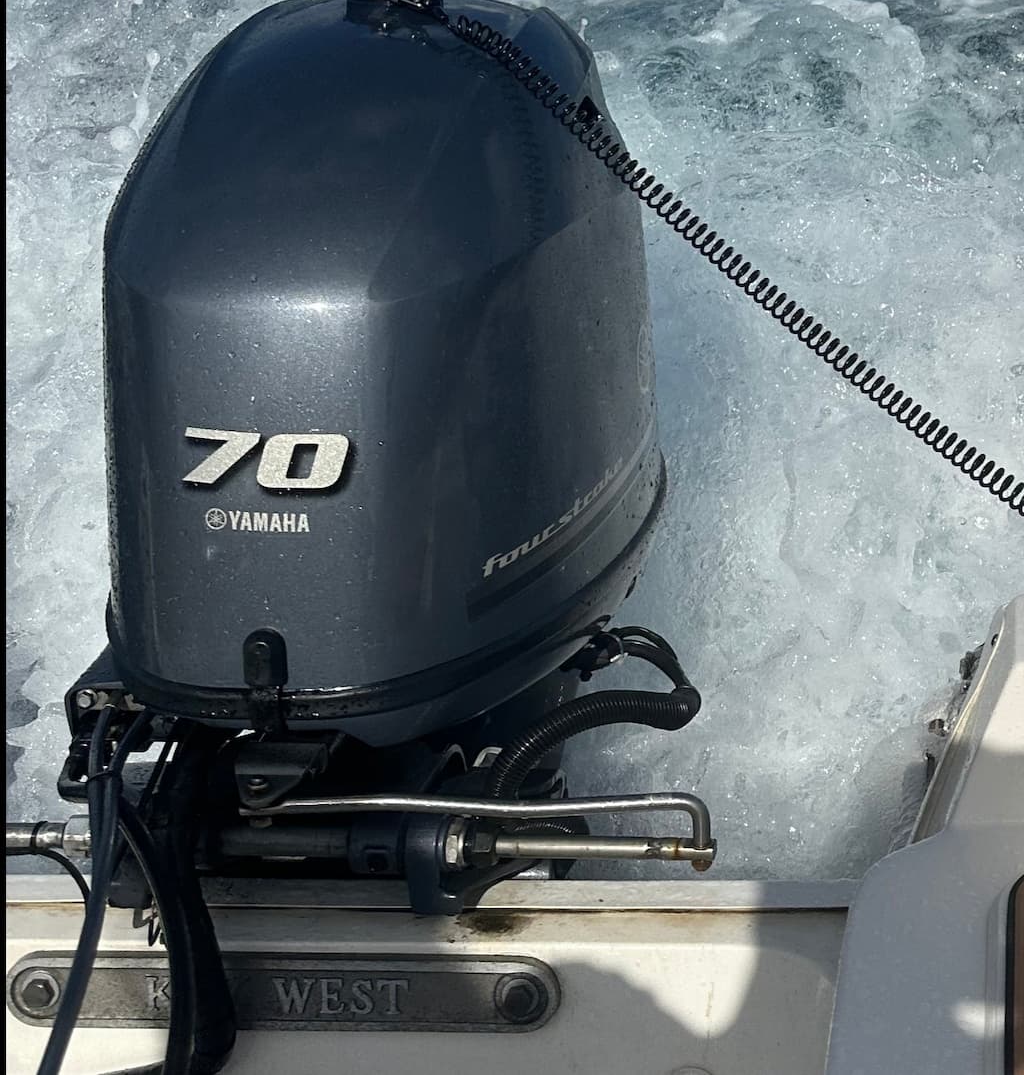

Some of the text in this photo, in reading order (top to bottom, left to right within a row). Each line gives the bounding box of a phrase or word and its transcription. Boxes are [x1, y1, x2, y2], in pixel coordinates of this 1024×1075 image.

[181, 426, 350, 489] 70
[228, 510, 311, 533] YAMAHA
[272, 975, 410, 1015] WEST
